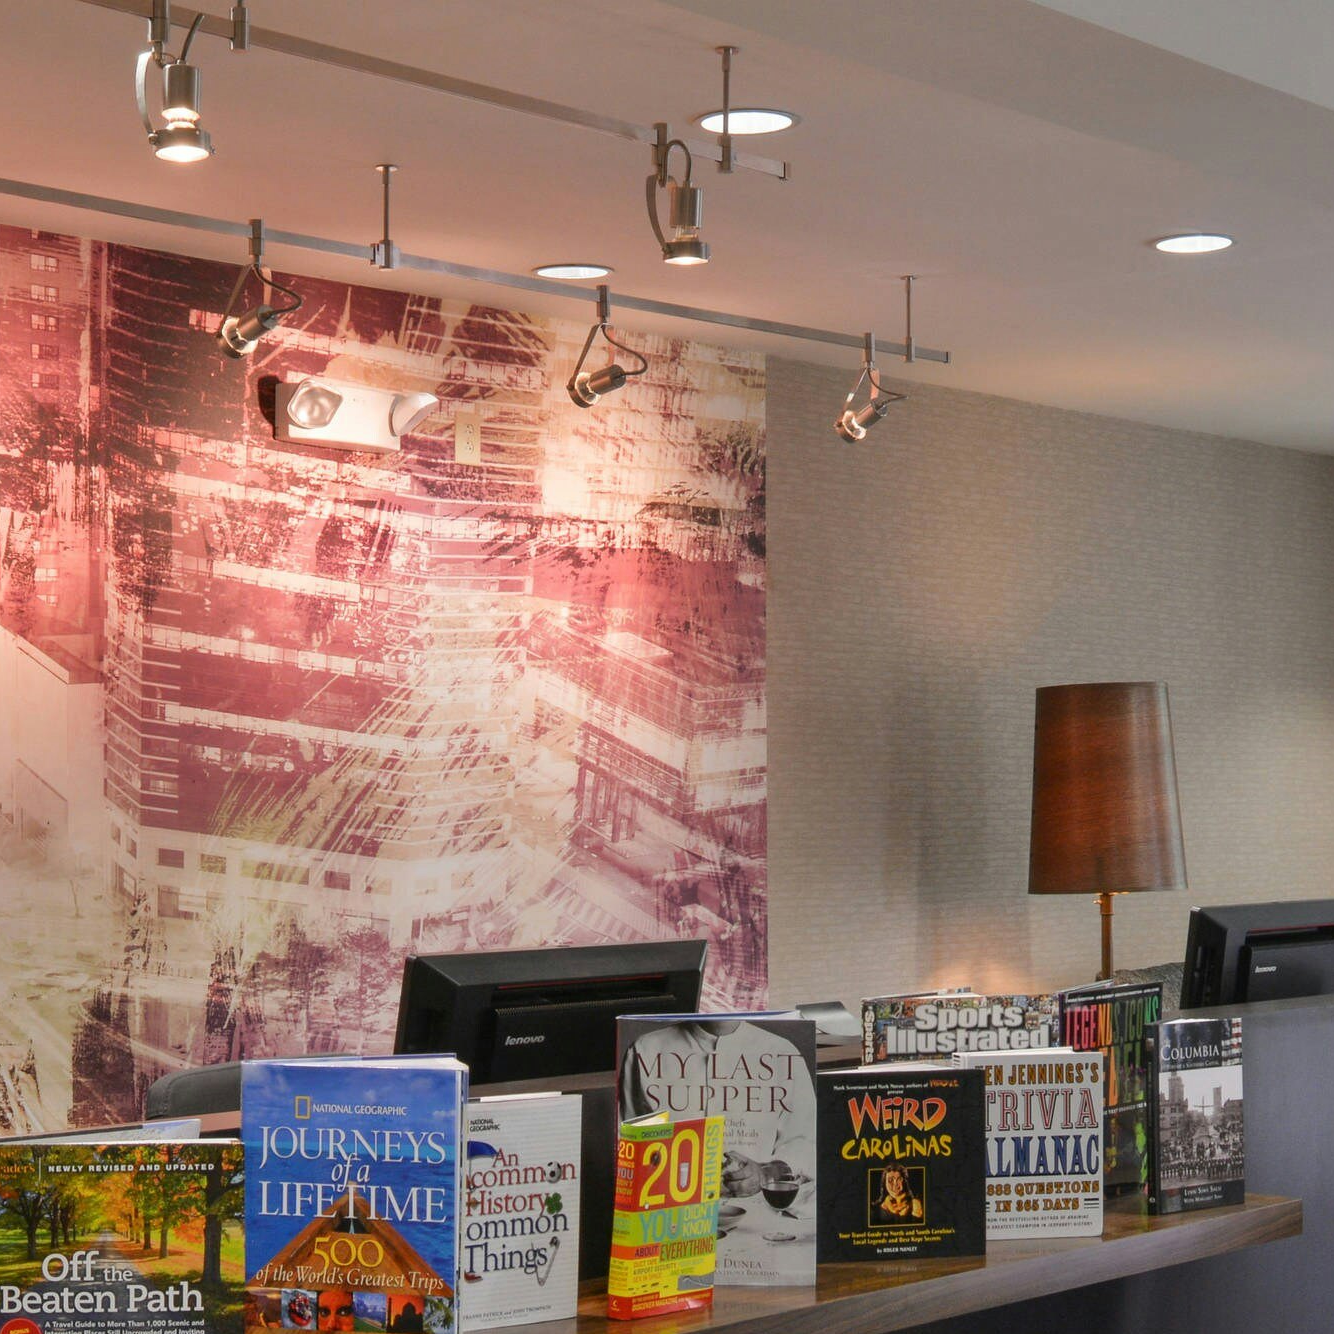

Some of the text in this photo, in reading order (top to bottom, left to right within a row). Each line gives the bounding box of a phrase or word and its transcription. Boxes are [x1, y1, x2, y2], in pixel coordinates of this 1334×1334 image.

[1255, 965, 1277, 974] lenovo
[915, 1003, 1024, 1033] Sports
[505, 1034, 545, 1046] lenovo
[886, 1024, 1052, 1055] Illustrated
[1160, 1044, 1220, 1062] COLUMBIA
[636, 1052, 803, 1081] MY LAST
[981, 1062, 1100, 1086] EN JENNINGS'S
[313, 1104, 407, 1116] NATIONAL GEOGRAPHIC
[646, 1084, 794, 1112] SUPPER
[985, 1088, 1099, 1131] TRIVIA
[470, 1118, 494, 1126] NATIONAL
[470, 1124, 500, 1132] GEOGRAPHIC
[259, 1126, 447, 1169] JOURNEYS
[493, 1148, 519, 1168] An
[618, 1141, 635, 1159] 20
[48, 1163, 215, 1173] NEWLY REVISED AND UPDATED
[331, 1152, 371, 1192] of a
[466, 1162, 577, 1189] common
[639, 1129, 700, 1207] 20
[258, 1181, 447, 1223] LIFETIME
[986, 1180, 1100, 1197] 888 QUESTIONS
[466, 1190, 549, 1217] History
[995, 1197, 1080, 1212] IN 365 DAYS
[467, 1213, 569, 1241] ommon
[639, 1207, 682, 1243] YOU
[314, 1235, 384, 1274] 500
[465, 1241, 548, 1275] Things
[635, 1236, 714, 1262] ABOUT EVERYTHING
[41, 1250, 133, 1282] Off the
[256, 1261, 444, 1296] of the World's Greatest Trips
[0, 1281, 204, 1314] Beaten Path
[146, 1320, 166, 1328] 1,000
